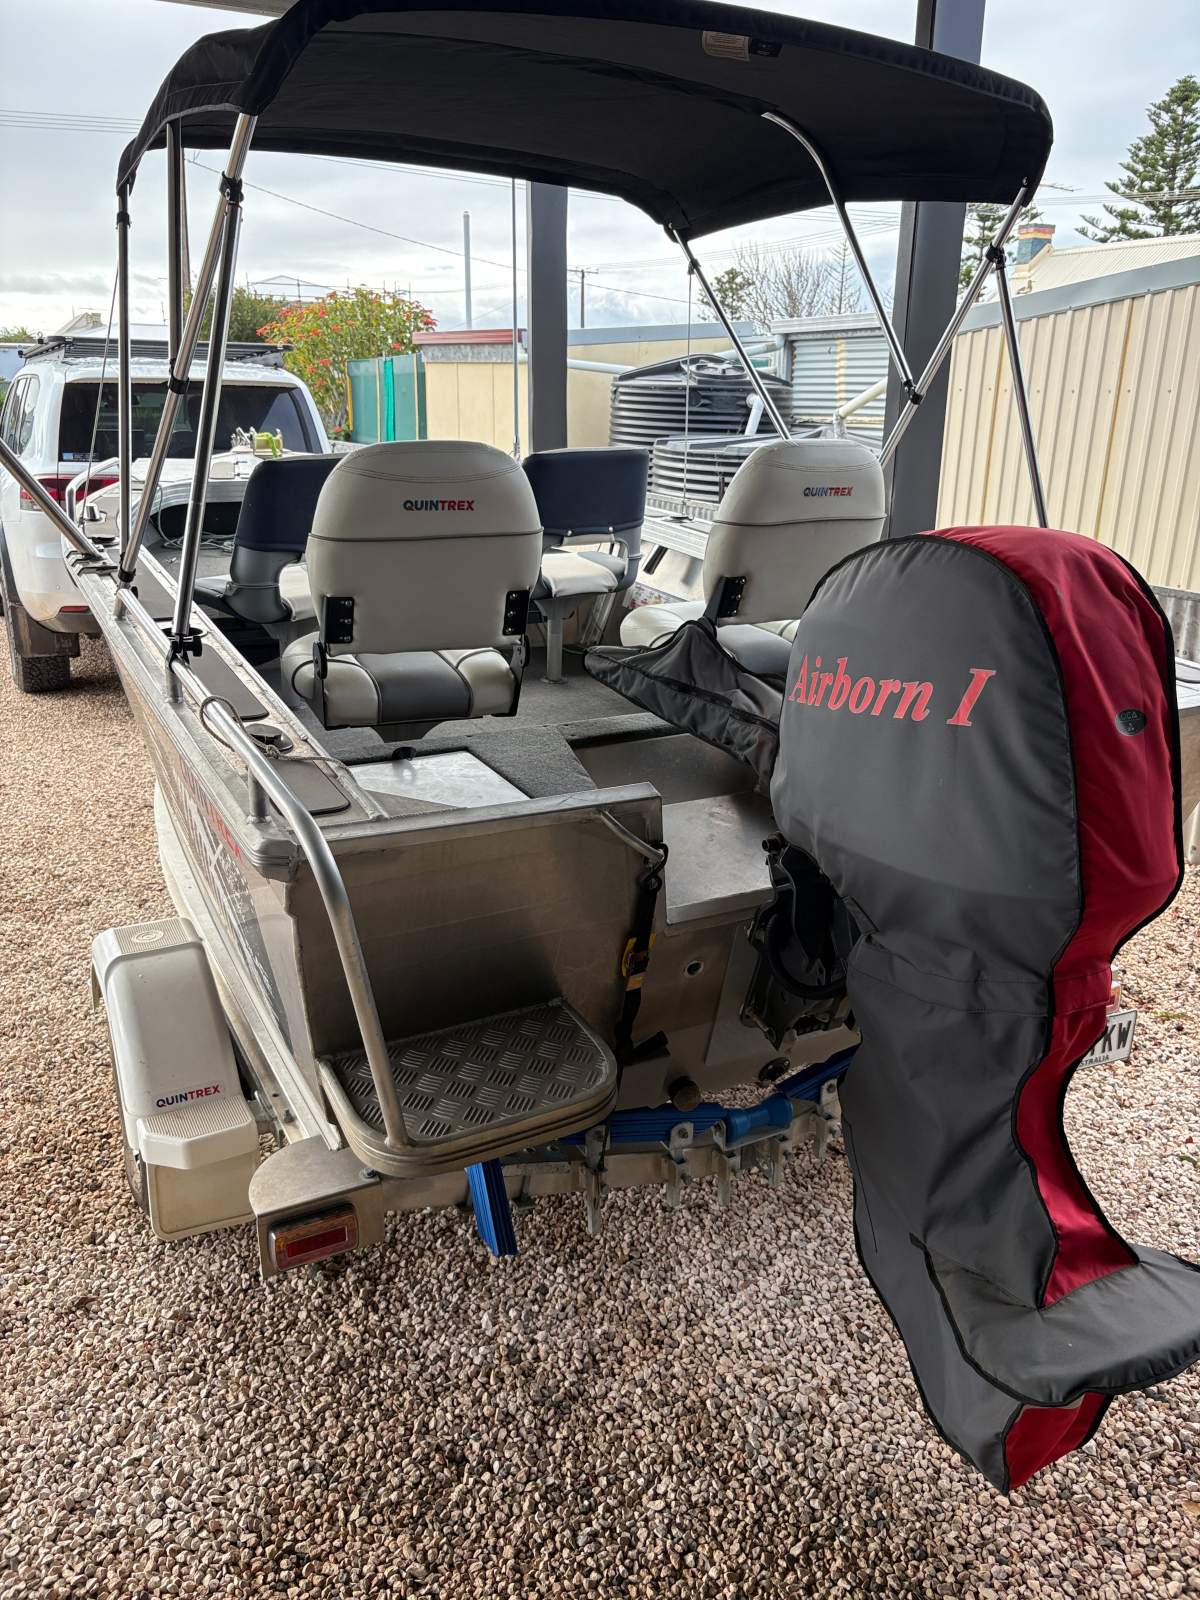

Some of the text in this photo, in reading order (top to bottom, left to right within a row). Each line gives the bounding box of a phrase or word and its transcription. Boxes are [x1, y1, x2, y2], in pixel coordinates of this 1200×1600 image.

[803, 486, 853, 497] QUINTREX
[403, 499, 475, 511] QUINTREX
[788, 655, 997, 727] Airborn I
[1090, 1020, 1132, 1056] KW
[1079, 1054, 1110, 1067] STRALIA
[156, 1084, 220, 1108] QUINTREX
